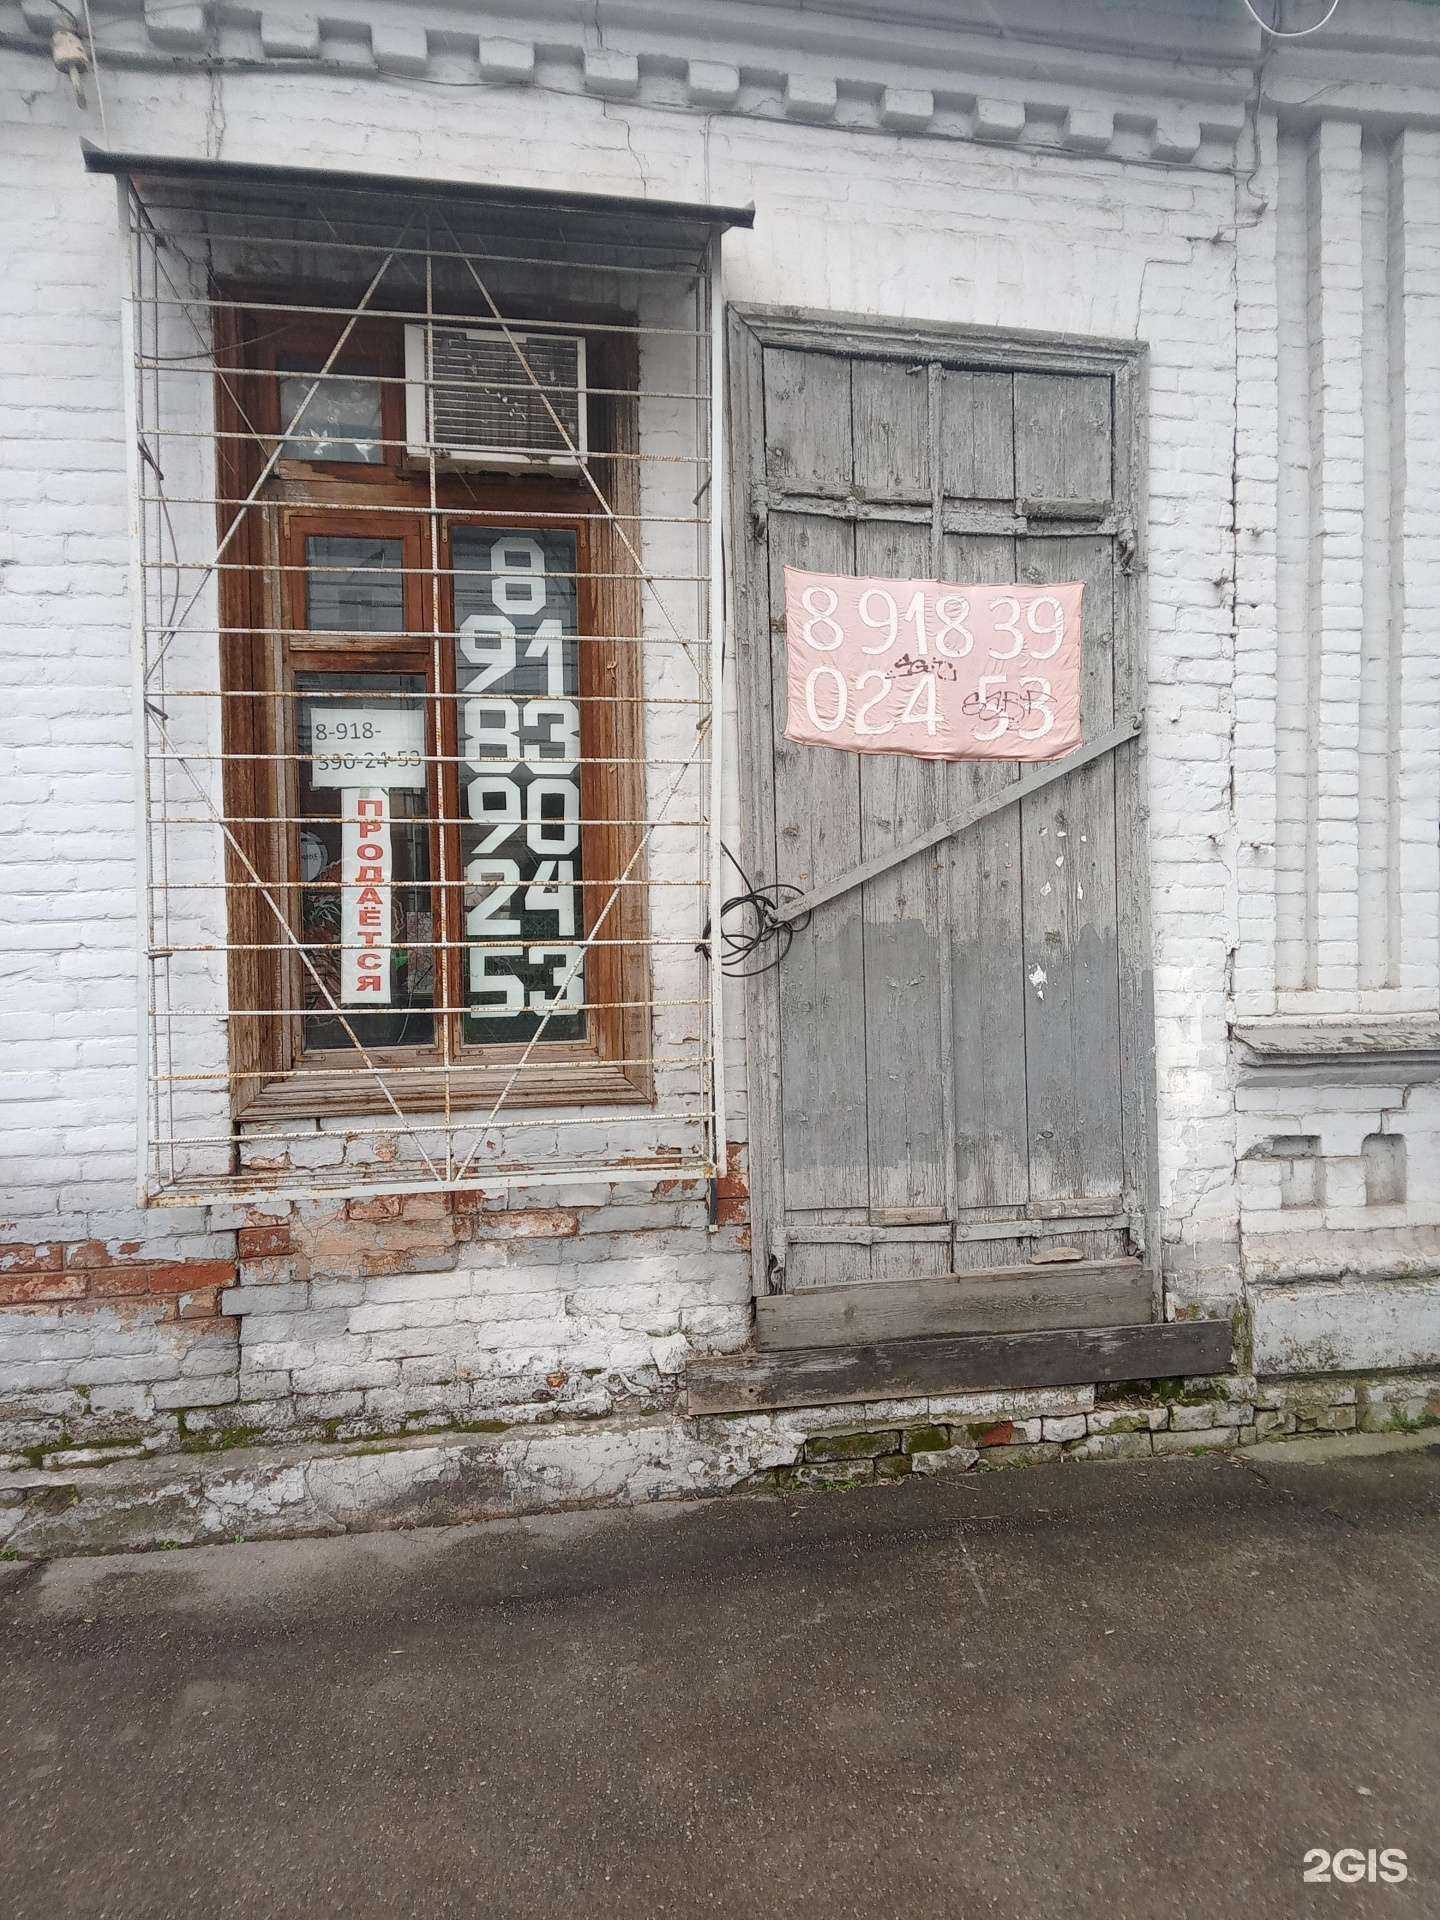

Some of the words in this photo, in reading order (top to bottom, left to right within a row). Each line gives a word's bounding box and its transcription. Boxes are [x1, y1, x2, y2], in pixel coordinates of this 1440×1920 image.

[490, 537, 547, 615] 8
[459, 614, 564, 697] 91
[802, 585, 845, 651] 8
[858, 588, 975, 658] 918
[987, 595, 1065, 660] 39
[315, 721, 382, 740] 8-918-
[463, 699, 581, 775] 83
[804, 665, 944, 736] 024
[973, 672, 1055, 742] 53
[318, 750, 421, 771] 390-2453
[467, 776, 580, 855] 90
[355, 799, 384, 992] ПРОДАЁТСЯ
[465, 858, 576, 936] 24
[470, 945, 585, 1018] 53
